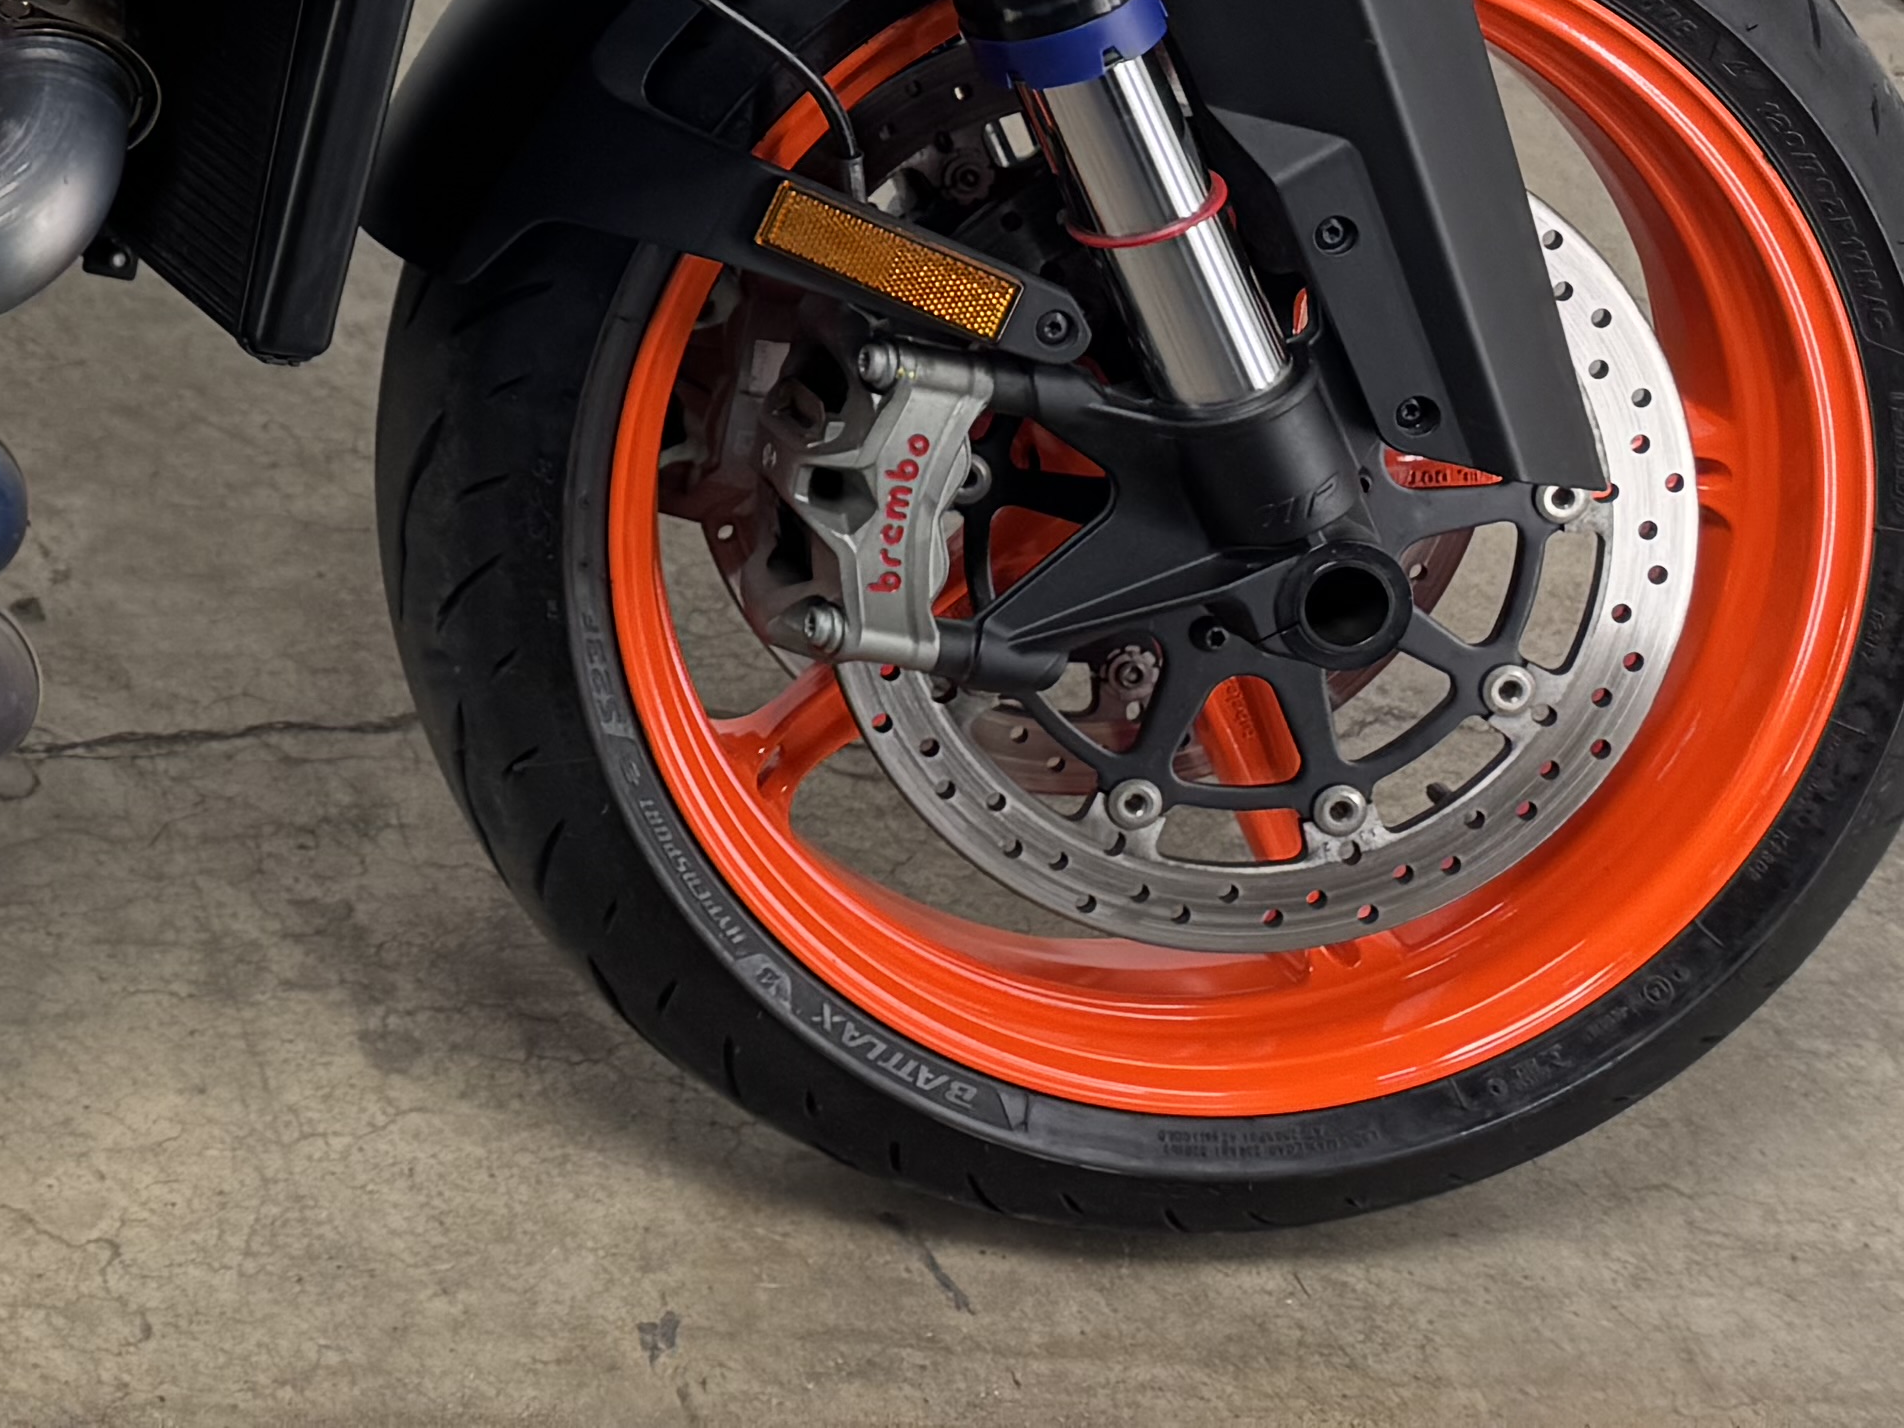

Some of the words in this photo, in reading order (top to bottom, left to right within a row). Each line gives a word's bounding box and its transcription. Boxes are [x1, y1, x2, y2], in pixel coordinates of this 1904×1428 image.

[865, 433, 931, 594] brembo
[638, 795, 747, 945] HYPERSPORT
[812, 1000, 979, 1110] BATTLAX
